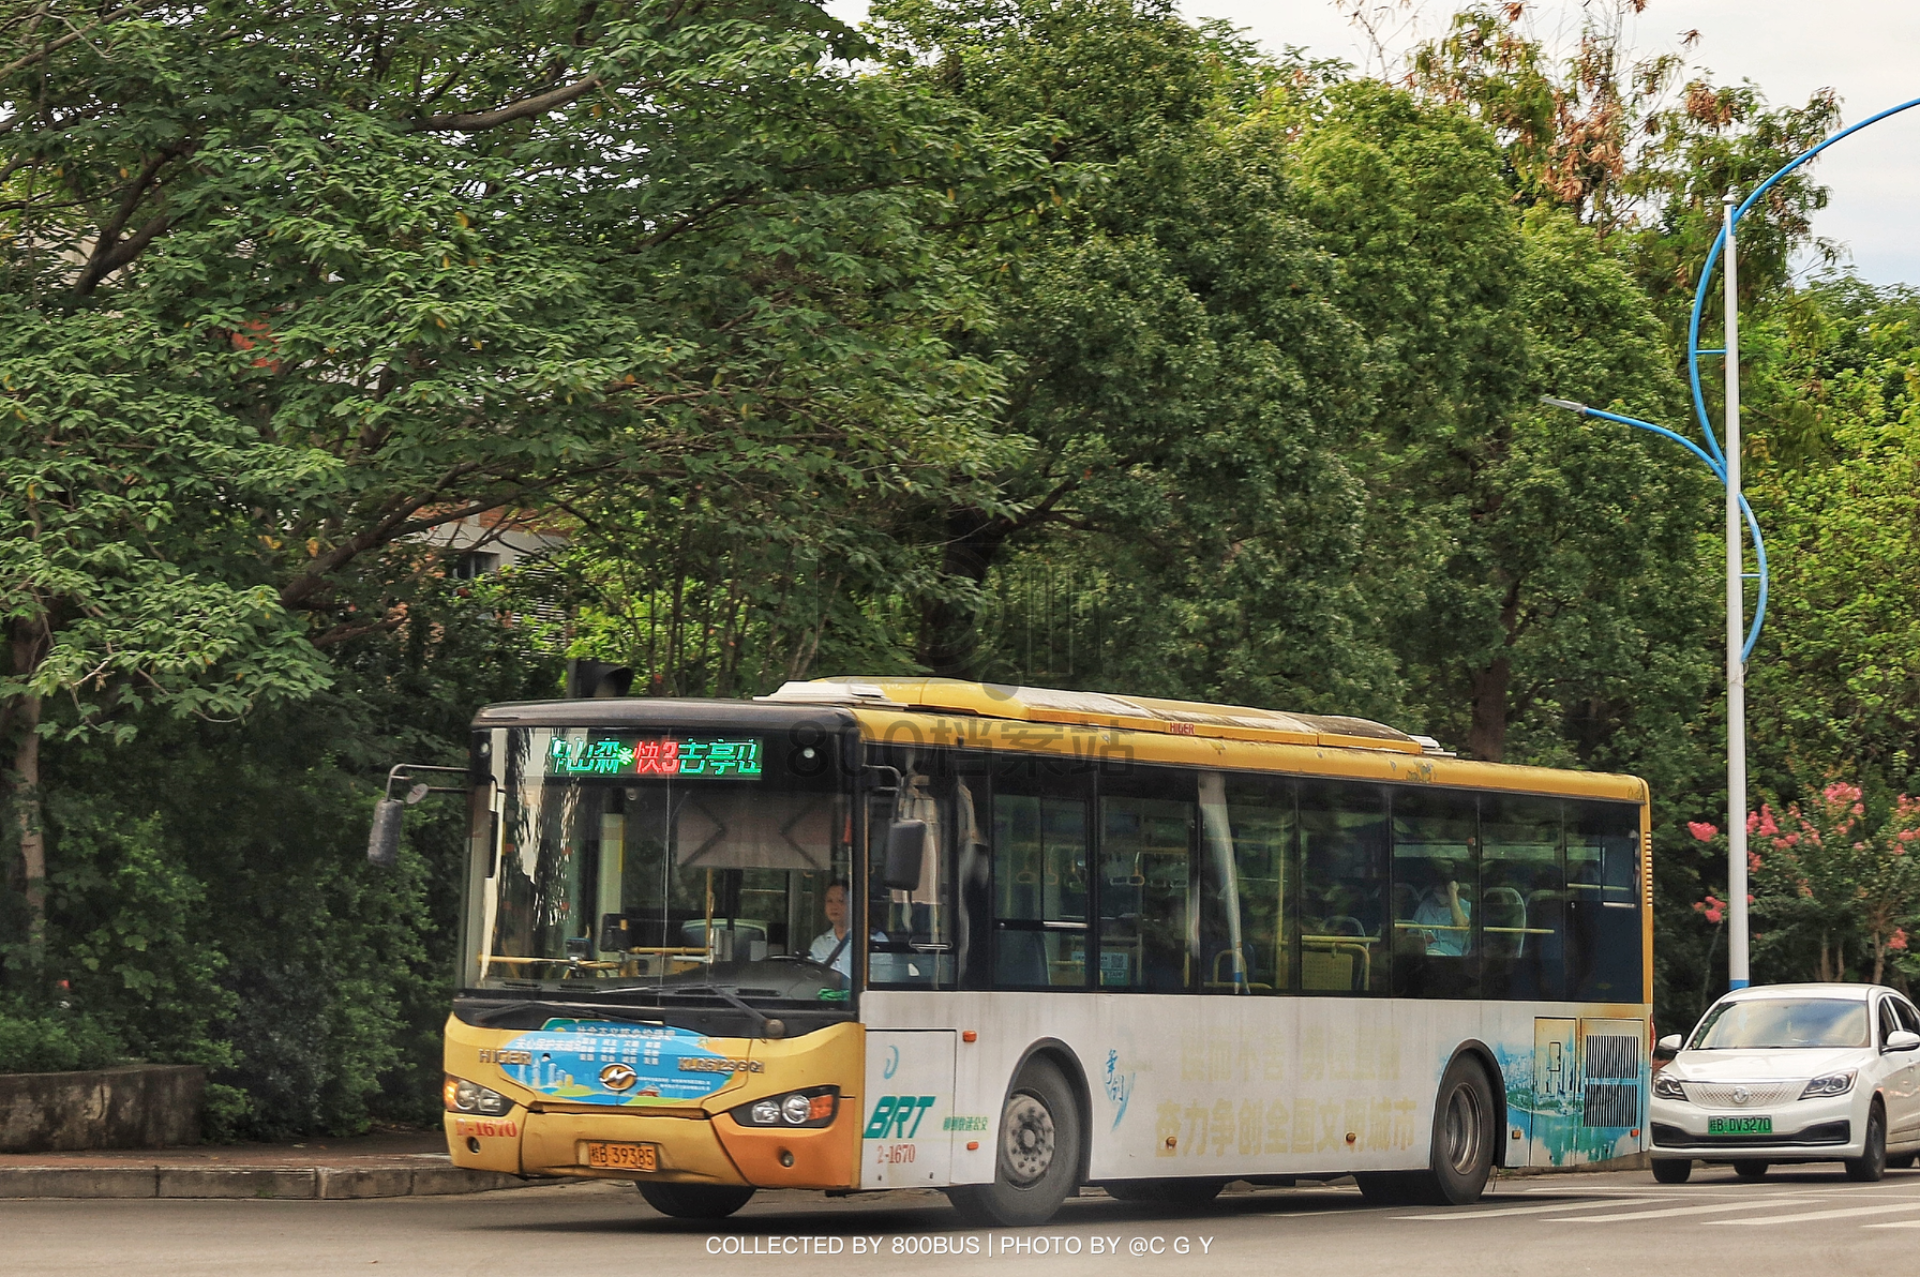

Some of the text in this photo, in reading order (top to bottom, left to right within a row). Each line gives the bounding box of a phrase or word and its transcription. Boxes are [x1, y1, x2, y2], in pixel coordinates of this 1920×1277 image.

[479, 1049, 531, 1065] HIGER
[863, 1096, 936, 1138] BRT
[877, 1144, 915, 1164] 2-1670
